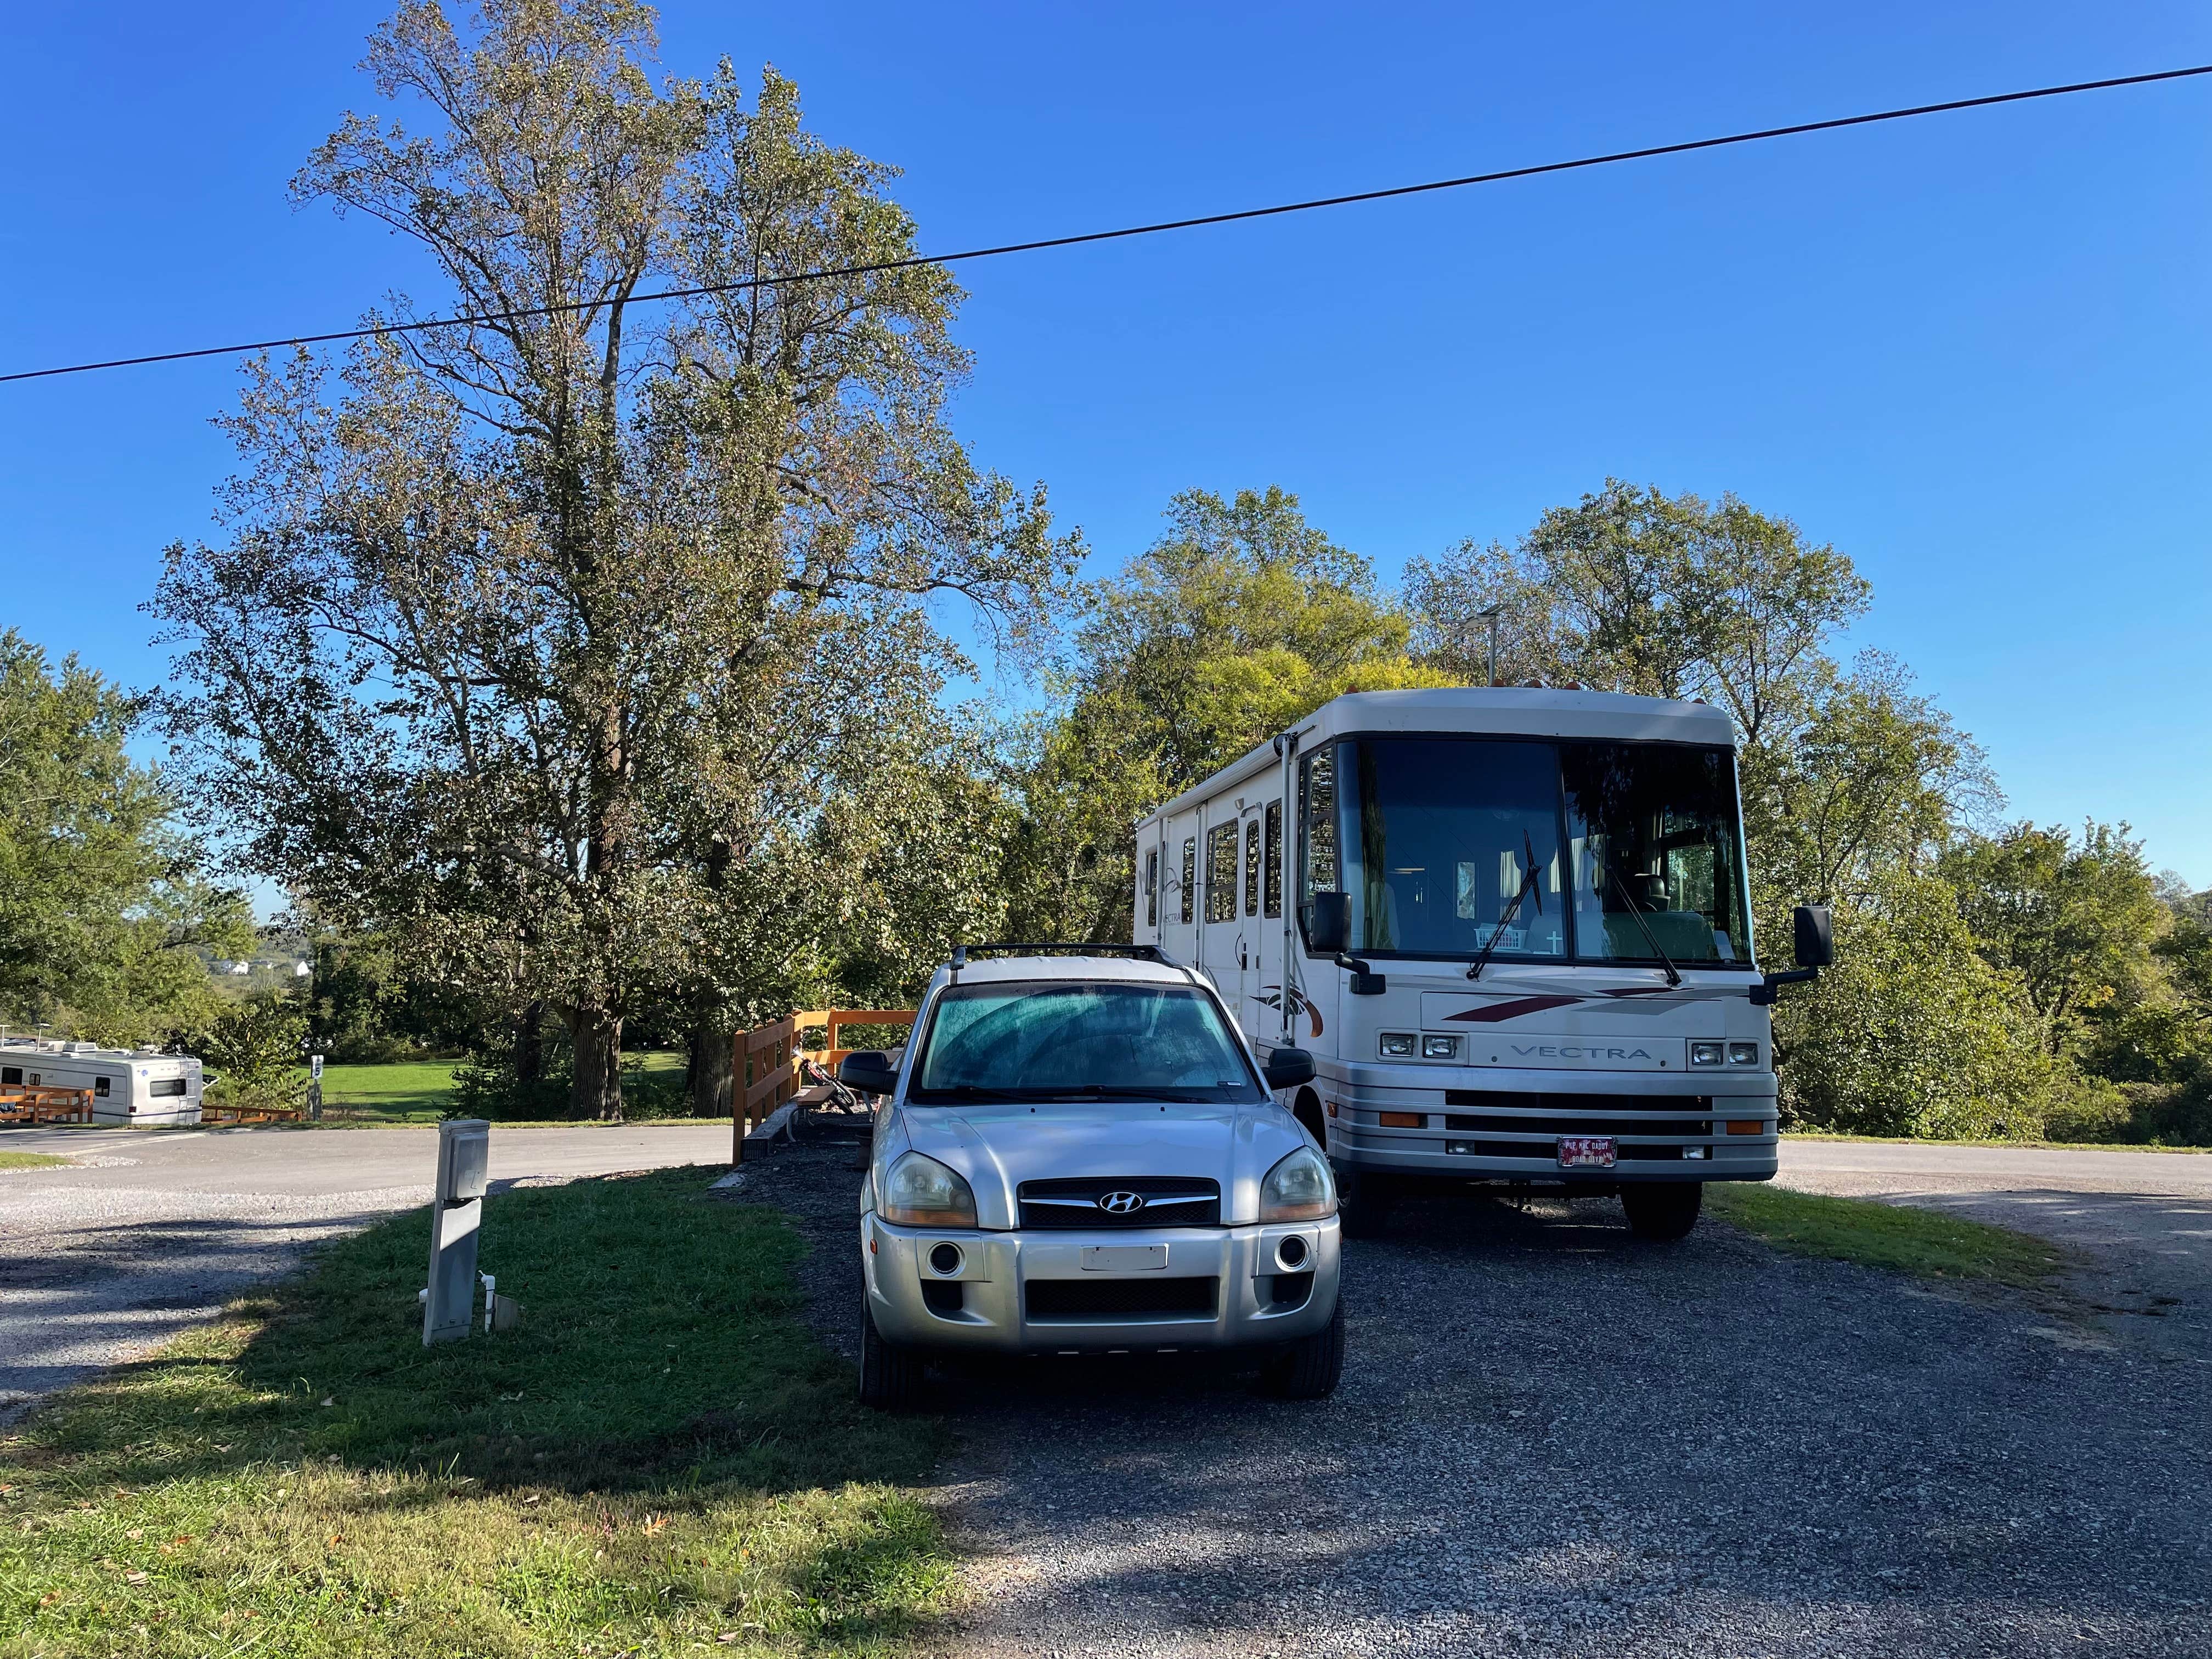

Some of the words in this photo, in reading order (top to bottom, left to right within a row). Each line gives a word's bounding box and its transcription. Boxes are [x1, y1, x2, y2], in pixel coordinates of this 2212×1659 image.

[1162, 913, 1181, 923] VECTRA
[1510, 1045, 1652, 1059] VECTRA
[315, 1067, 320, 1076] 5
